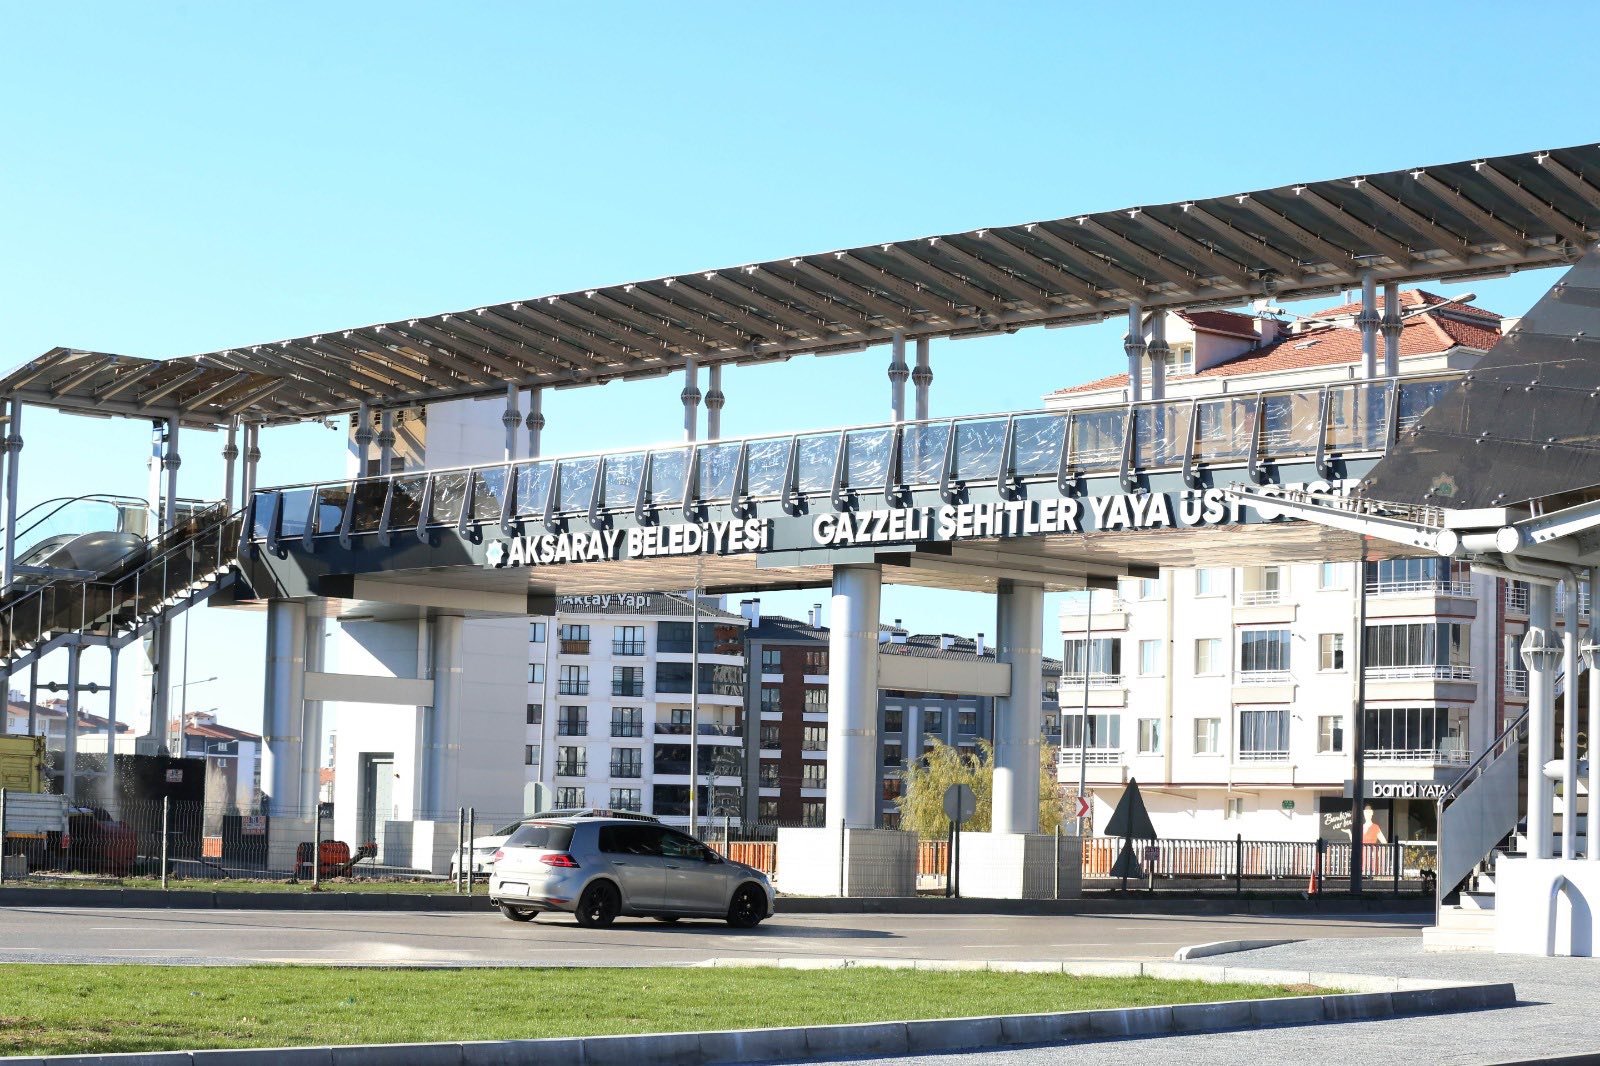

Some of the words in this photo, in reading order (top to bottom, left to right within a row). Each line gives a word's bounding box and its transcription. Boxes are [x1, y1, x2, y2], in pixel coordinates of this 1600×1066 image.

[813, 507, 929, 545] GAZZELİ
[938, 498, 1078, 540] ŞEHİTLER
[1089, 492, 1169, 528] YAYA
[1179, 489, 1246, 525] ÜST
[508, 529, 621, 565] AKSARAY
[627, 518, 768, 557] BELEDİYESİ
[617, 593, 651, 609] Yapı
[1372, 781, 1417, 797] bambi
